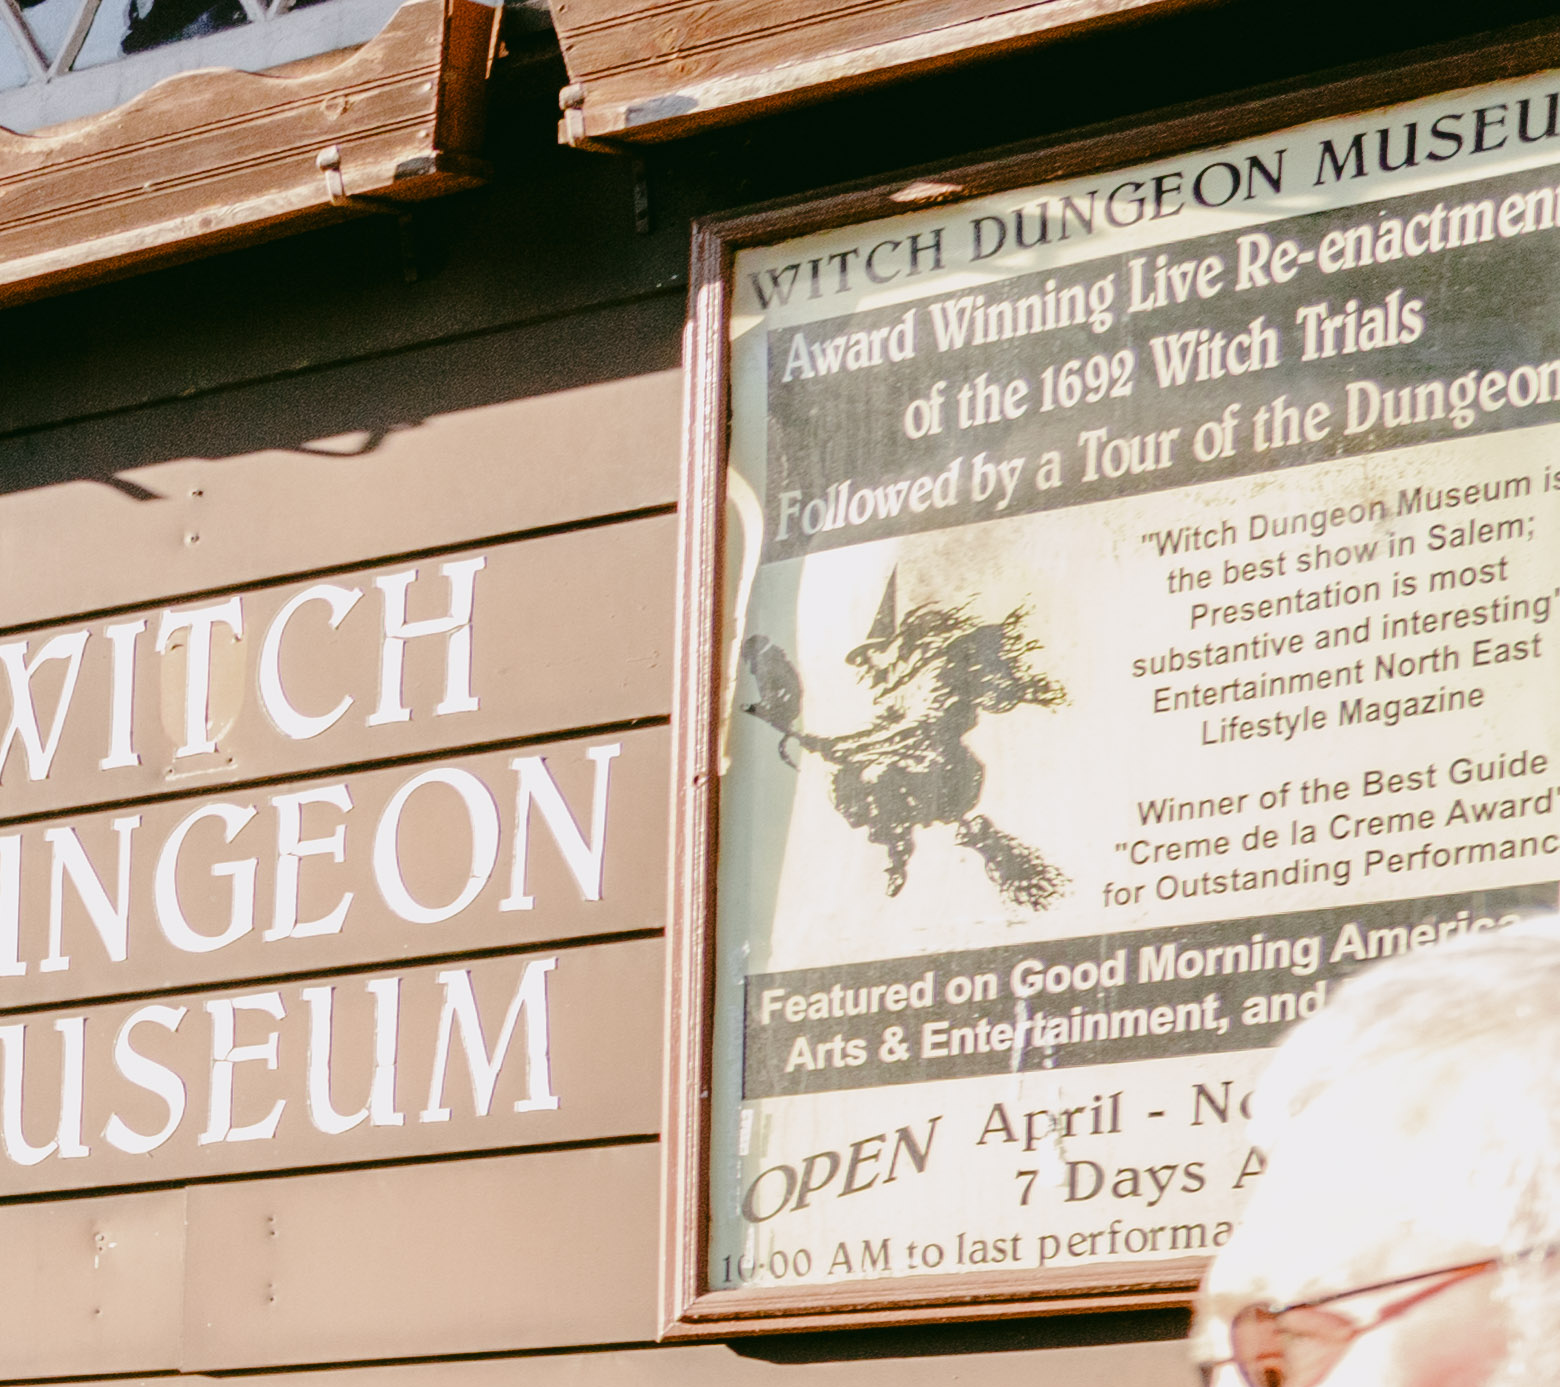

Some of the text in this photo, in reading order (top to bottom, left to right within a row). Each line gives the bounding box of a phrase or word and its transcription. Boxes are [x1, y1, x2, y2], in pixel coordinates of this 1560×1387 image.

[747, 227, 946, 311] WITCH
[970, 149, 1287, 263] DUNGEON
[781, 308, 917, 383] Award
[929, 271, 1116, 353] Winning
[1127, 253, 1225, 313] Live
[904, 287, 1425, 440] of the 1692 Witch Trials
[775, 358, 1560, 542] Followed by a Tour of the Dungeon
[1141, 519, 1238, 558] "Witch
[1248, 497, 1387, 542] Dungeon
[1395, 472, 1532, 518] Museum
[1167, 513, 1537, 595] the best show in Salem;
[1190, 556, 1510, 630] Presentation is most
[1131, 631, 1304, 678] substantive
[1315, 616, 1371, 651] and
[1152, 633, 1544, 714] Entertainment North East
[1200, 685, 1486, 746] Lifestyle Magazine
[1137, 749, 1550, 826] Winner of the Best Guide
[1114, 834, 1231, 868] "Creme
[1241, 824, 1279, 852] de
[1290, 819, 1318, 847] la
[1328, 806, 1437, 843] Creme
[1101, 880, 1147, 909] for
[1155, 855, 1352, 902] Outstanding
[760, 910, 1522, 1027] Featured on Good Morning Ameri
[784, 980, 1328, 1074] Arts & Entertainment, and
[741, 1115, 944, 1224] OPEN
[976, 1091, 1124, 1153] April
[1014, 1169, 1040, 1206] 7
[1064, 1160, 1207, 1208] Days
[828, 1238, 891, 1275] AM
[907, 1238, 945, 1269] to
[956, 1231, 1024, 1265] last
[1038, 1219, 1243, 1267] performa
